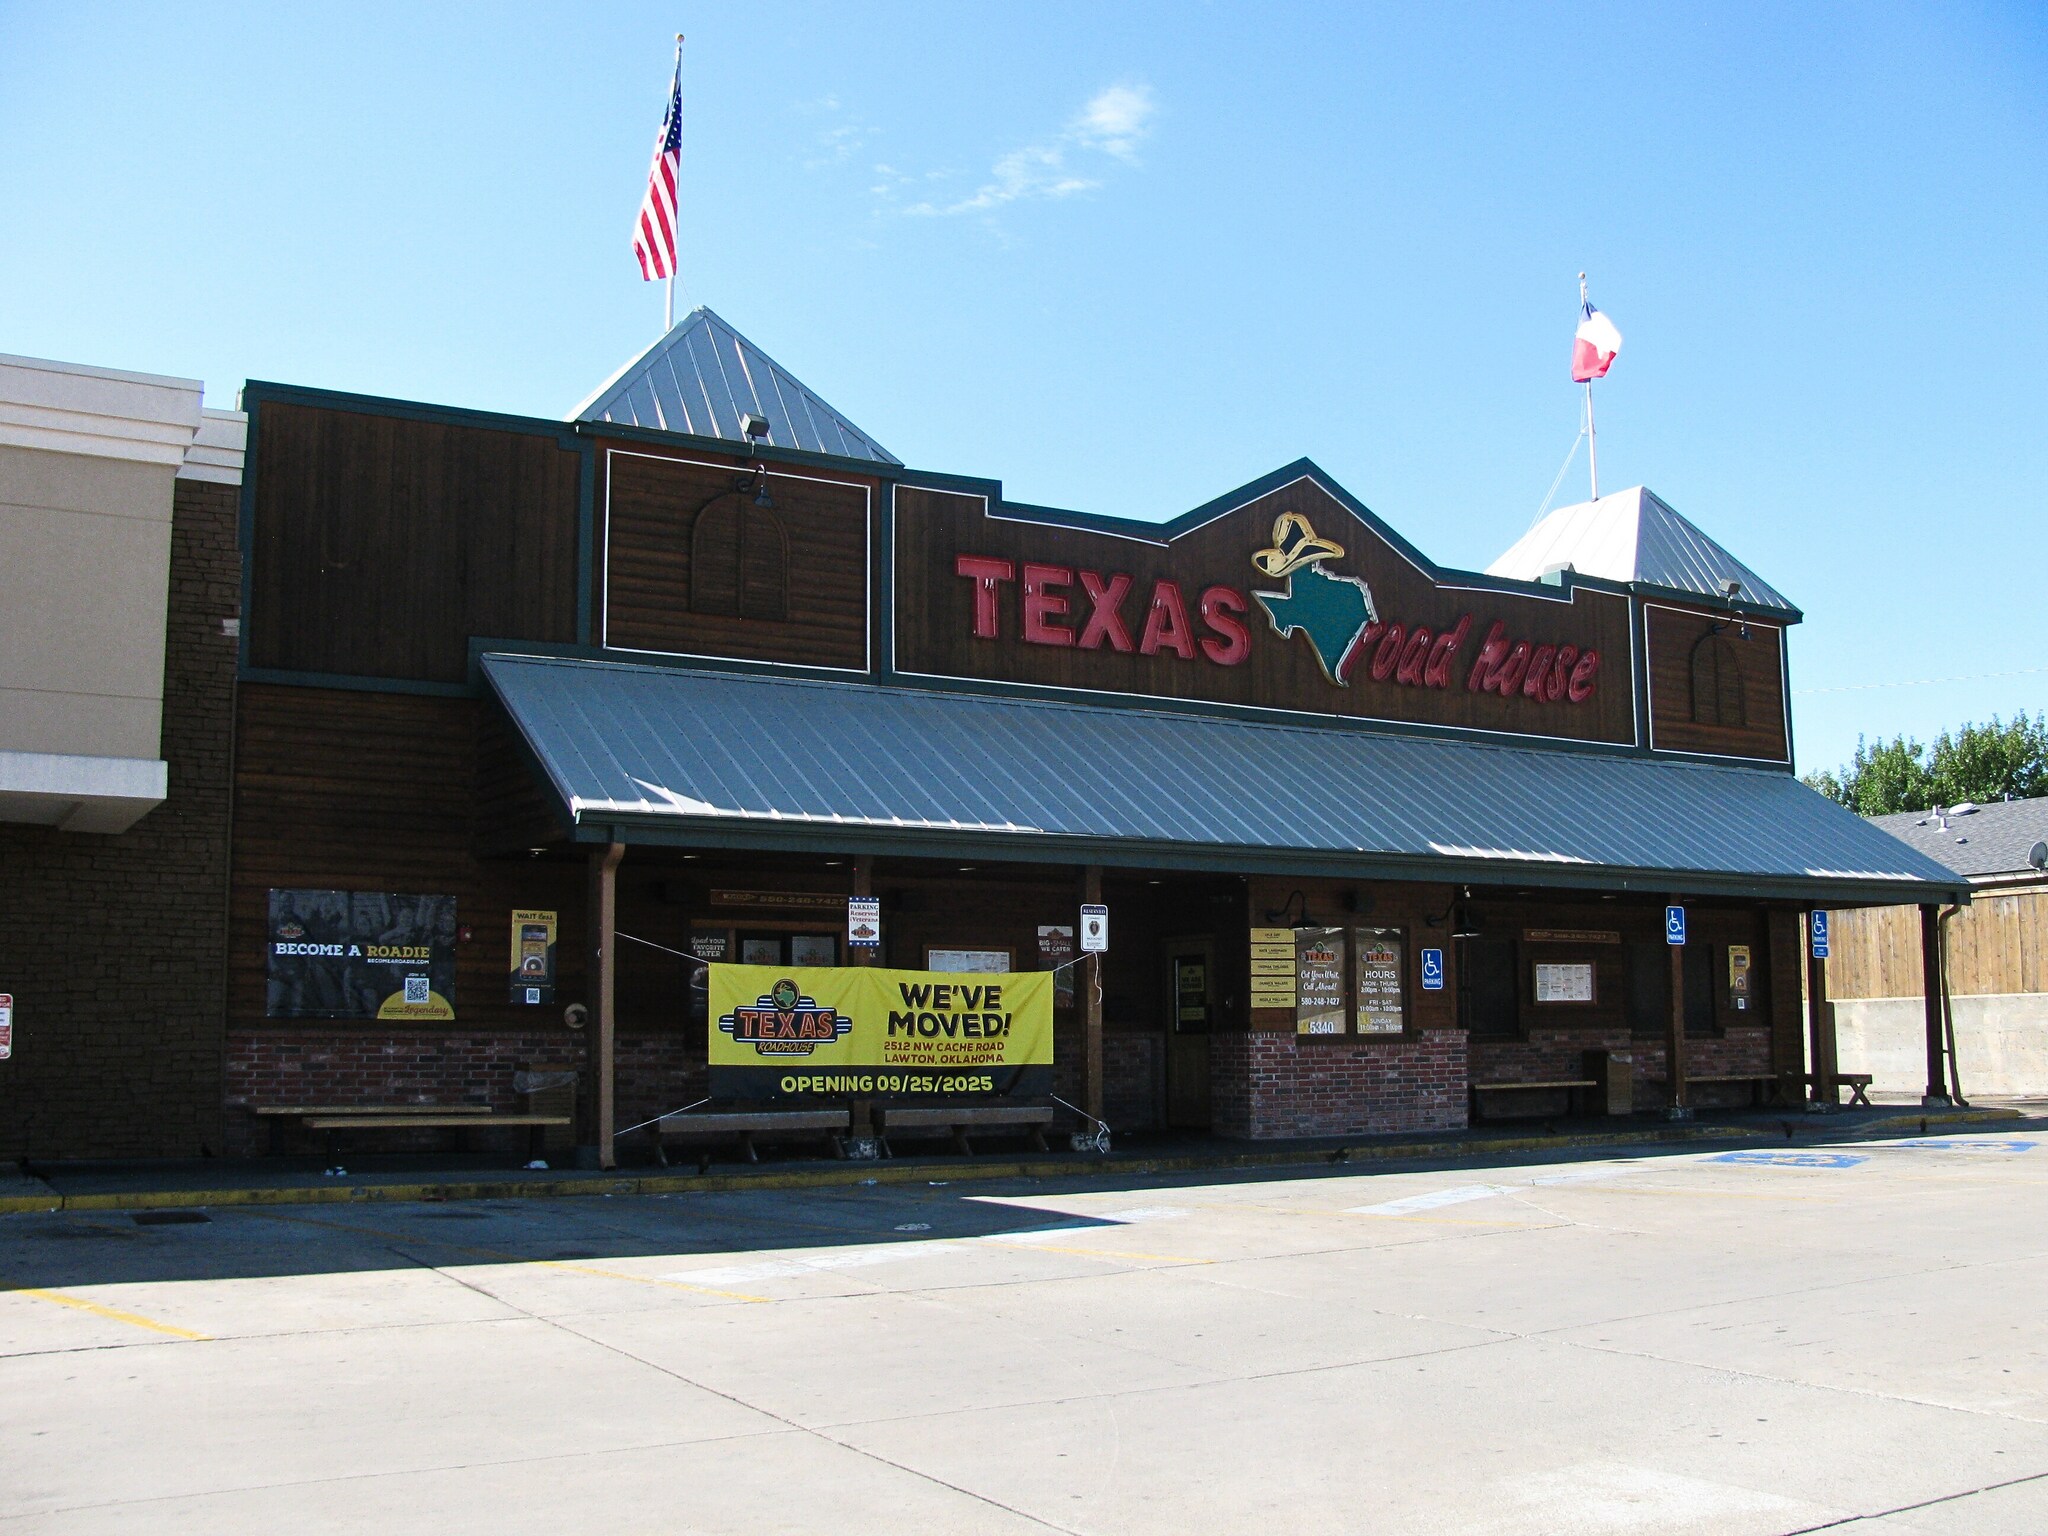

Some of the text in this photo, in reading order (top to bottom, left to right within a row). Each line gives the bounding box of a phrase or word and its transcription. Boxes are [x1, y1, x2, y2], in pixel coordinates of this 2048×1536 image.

[955, 554, 1251, 667] TEXAS
[1340, 613, 1601, 704] road house
[276, 942, 430, 958] BECOME A ROADIE
[1307, 952, 1334, 961] TEXAS
[1368, 953, 1392, 961] TEXAS
[899, 982, 1002, 1011] WE'VE
[404, 1005, 448, 1017] Legendary
[739, 1011, 834, 1038] TEXAS
[887, 1011, 1012, 1039] MOVED!
[1310, 1022, 1334, 1033] 5340
[758, 1041, 814, 1053] ROADHOUSE
[884, 1041, 1004, 1052] 2512 NW CACHE ROAD
[884, 1053, 1004, 1064] LAWTON, OKLAHOMA
[780, 1075, 993, 1092] OPENING 09/25/2025
